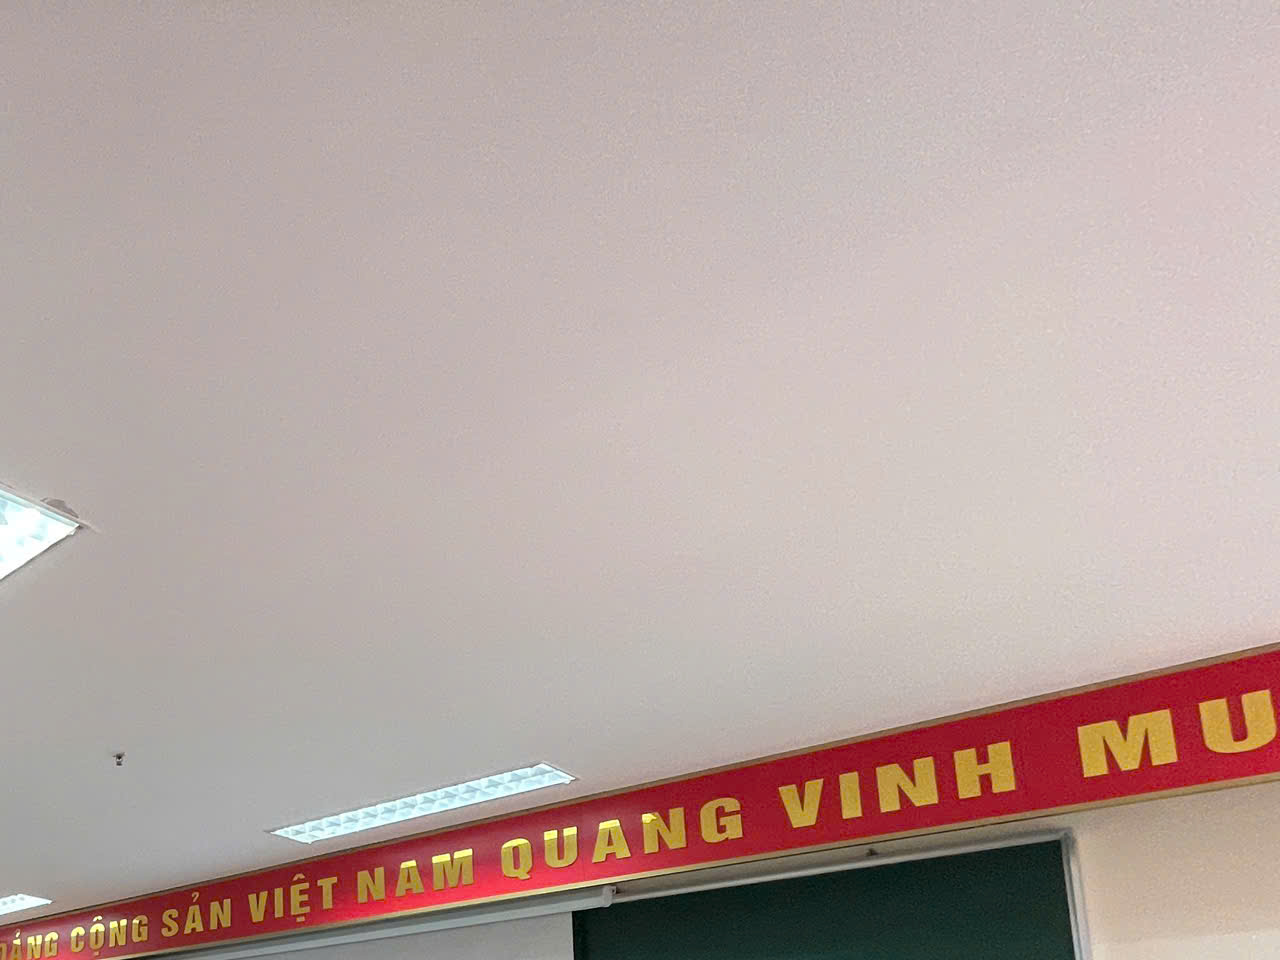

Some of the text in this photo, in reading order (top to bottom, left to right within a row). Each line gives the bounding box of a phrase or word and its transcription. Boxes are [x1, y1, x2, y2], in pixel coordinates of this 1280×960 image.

[70, 914, 150, 958] CỘNG
[161, 891, 232, 938] SẢN
[247, 873, 338, 924] VIỆT
[356, 848, 475, 904] NAM
[500, 796, 744, 880] QUANG
[778, 739, 1016, 829] VINH
[1076, 688, 1277, 778] MU
